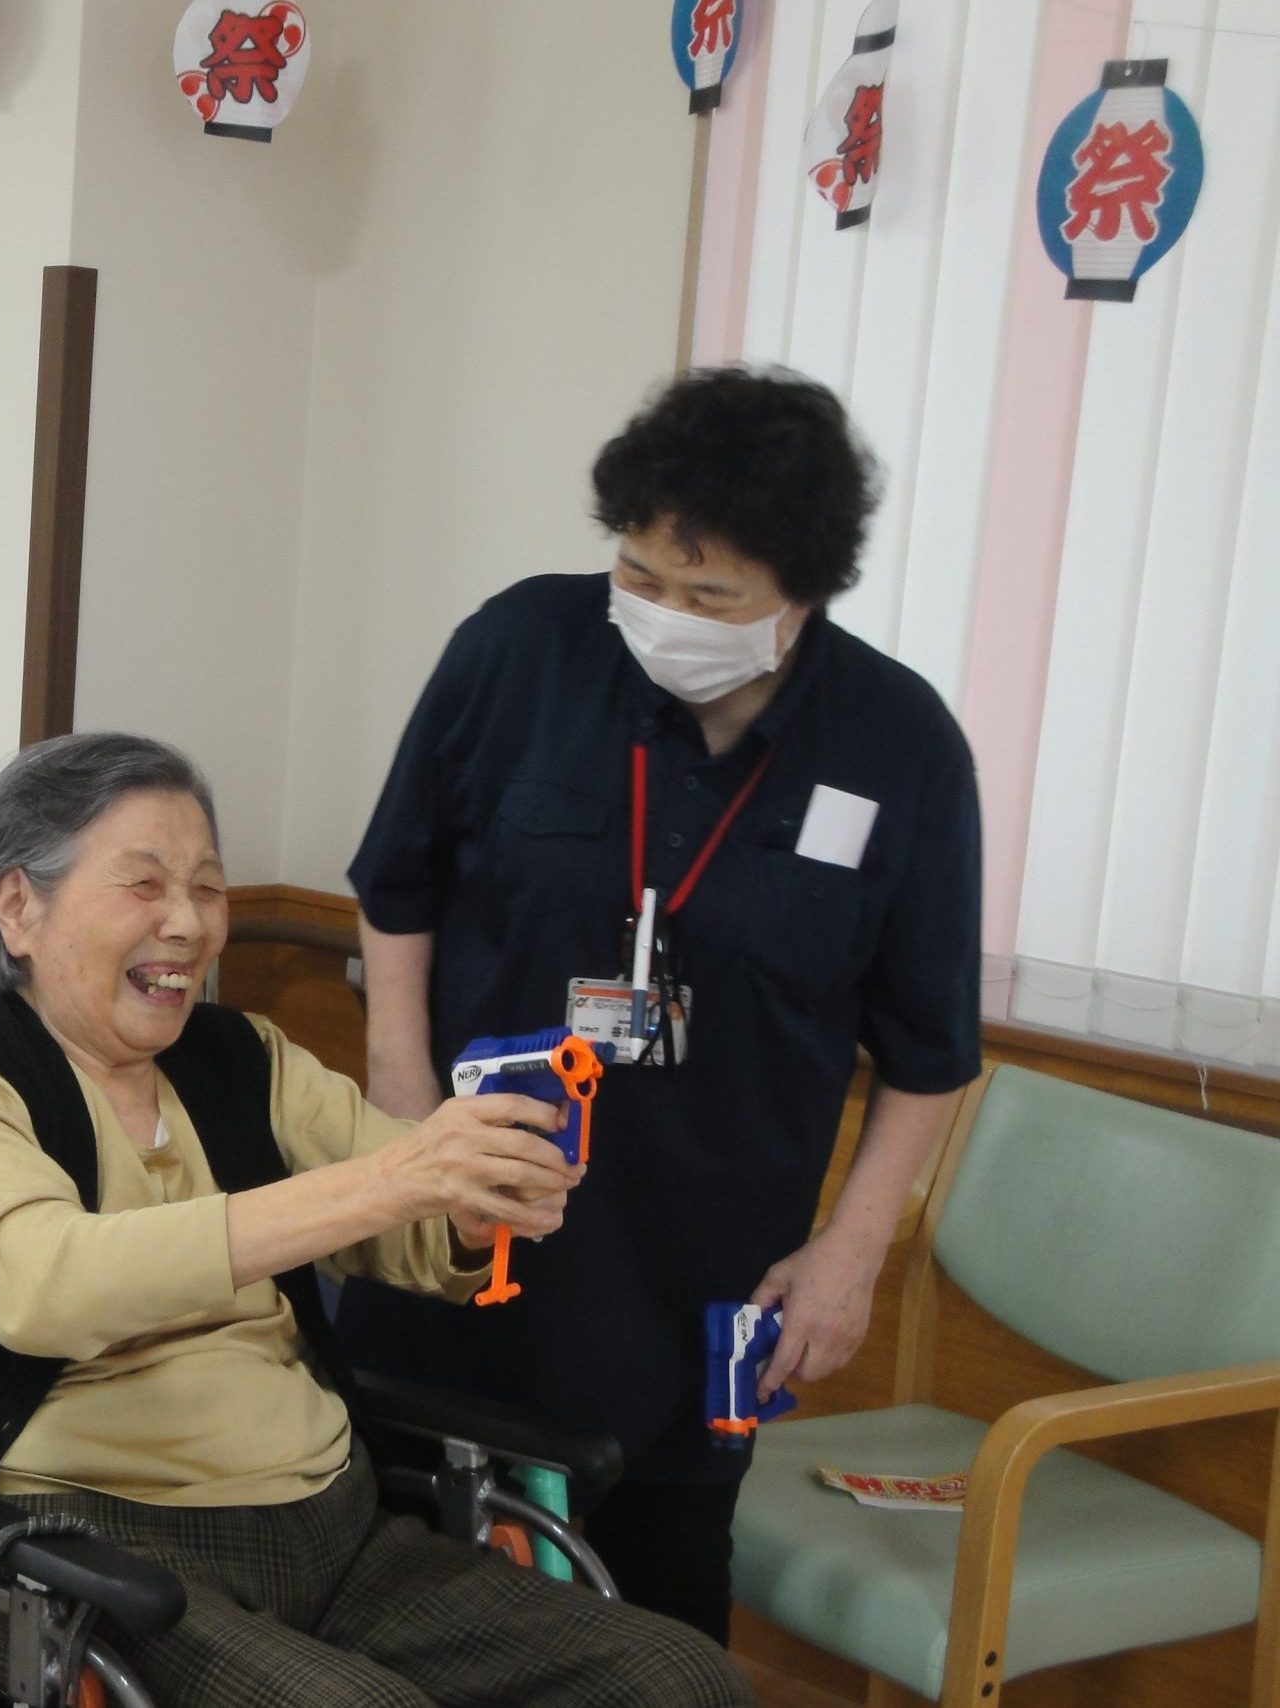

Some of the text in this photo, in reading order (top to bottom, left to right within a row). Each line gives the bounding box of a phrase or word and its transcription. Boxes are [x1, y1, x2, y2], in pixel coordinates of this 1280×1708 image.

[200, 9, 287, 105] 祭
[1063, 119, 1173, 243] 祭
[457, 1065, 482, 1082] NERF
